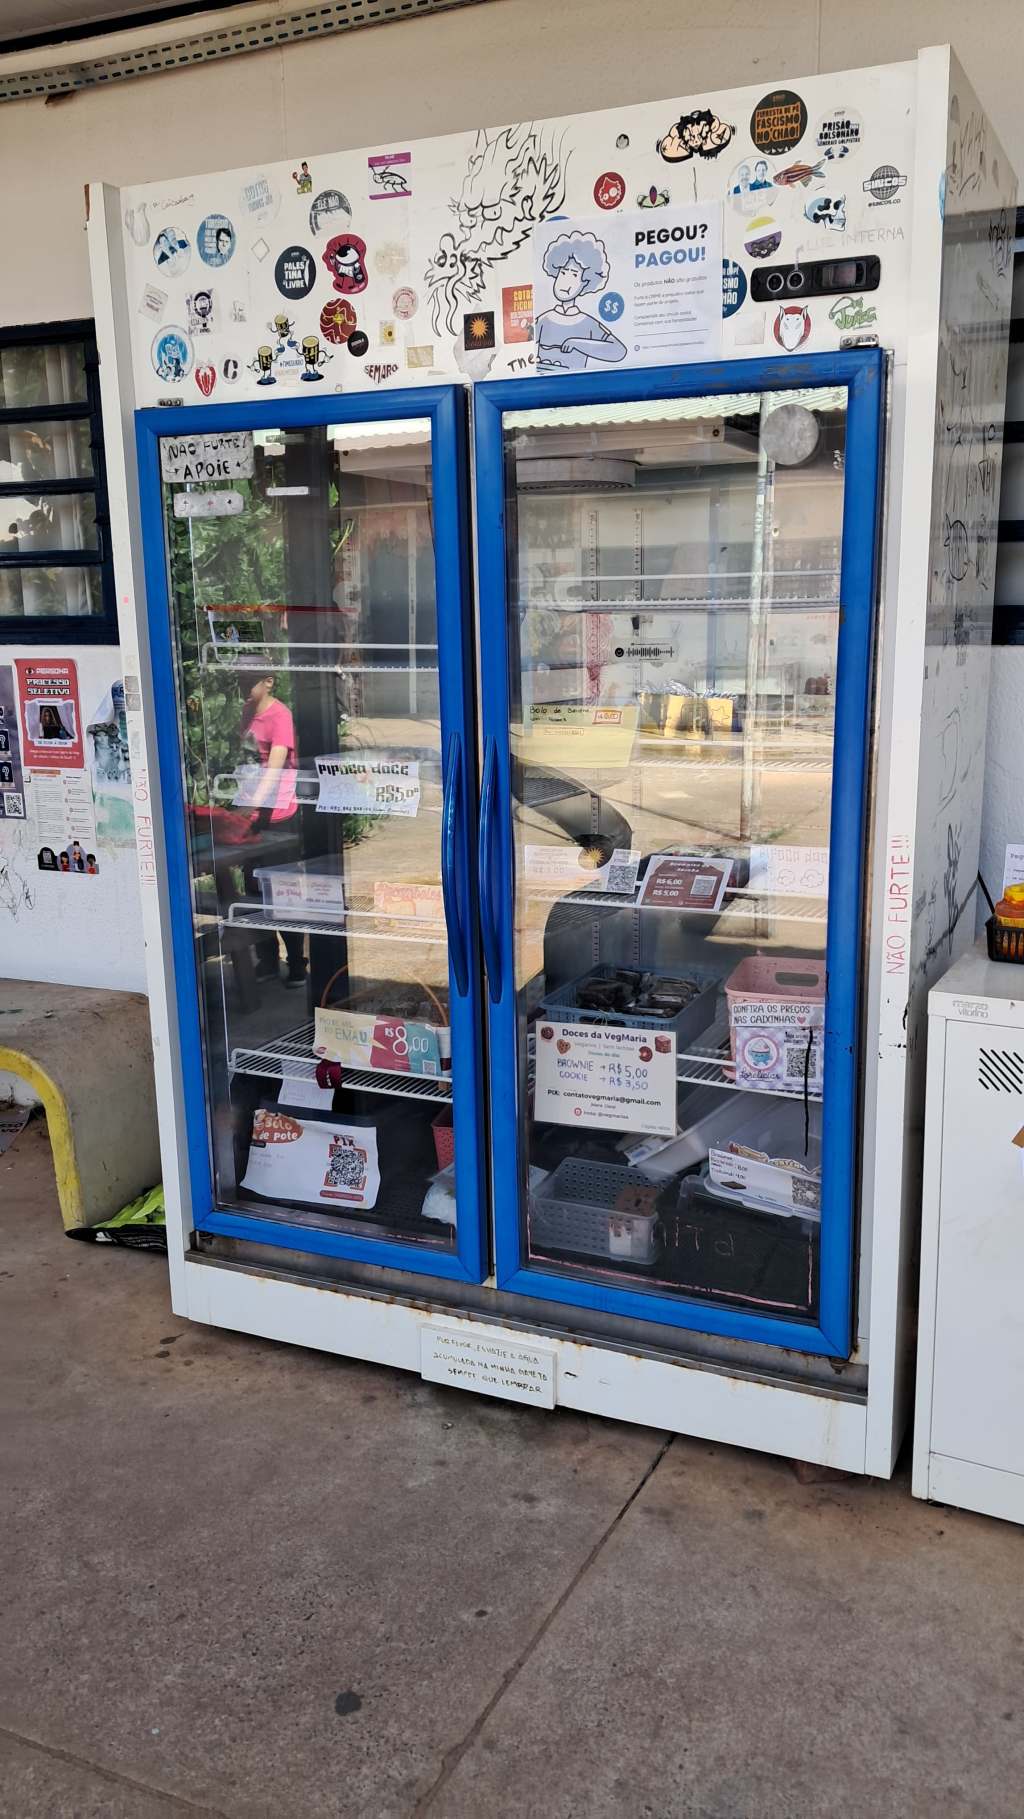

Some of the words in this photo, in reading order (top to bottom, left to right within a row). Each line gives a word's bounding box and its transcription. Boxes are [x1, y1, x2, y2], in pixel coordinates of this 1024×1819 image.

[757, 113, 800, 129] FASCISMO
[635, 224, 708, 246] PEGOU?
[635, 246, 706, 268] PAGOU!
[285, 270, 302, 279] TINA
[26, 678, 70, 686] PROCESSO
[27, 687, 70, 695] SELETIVO
[530, 705, 547, 714] Bolo
[886, 935, 905, 975] NÃO
[767, 1005, 778, 1013] OS
[734, 1016, 748, 1024] NAS
[562, 1028, 589, 1038] Doces
[591, 1031, 602, 1039] da
[605, 1032, 648, 1044] VegMaria
[557, 1058, 594, 1071] BROWNIE
[608, 1063, 622, 1075] R$
[624, 1065, 648, 1079] 5,00
[560, 1071, 588, 1082] COOKIE
[609, 1076, 622, 1086] R$
[625, 1079, 649, 1091] 3,50
[563, 1091, 662, 1106] contatovegmaria@gmail.com
[274, 1131, 298, 1141] pote
[333, 1135, 356, 1147] PIX
[491, 1364, 515, 1374] MINHA
[482, 1375, 499, 1384] QUE
